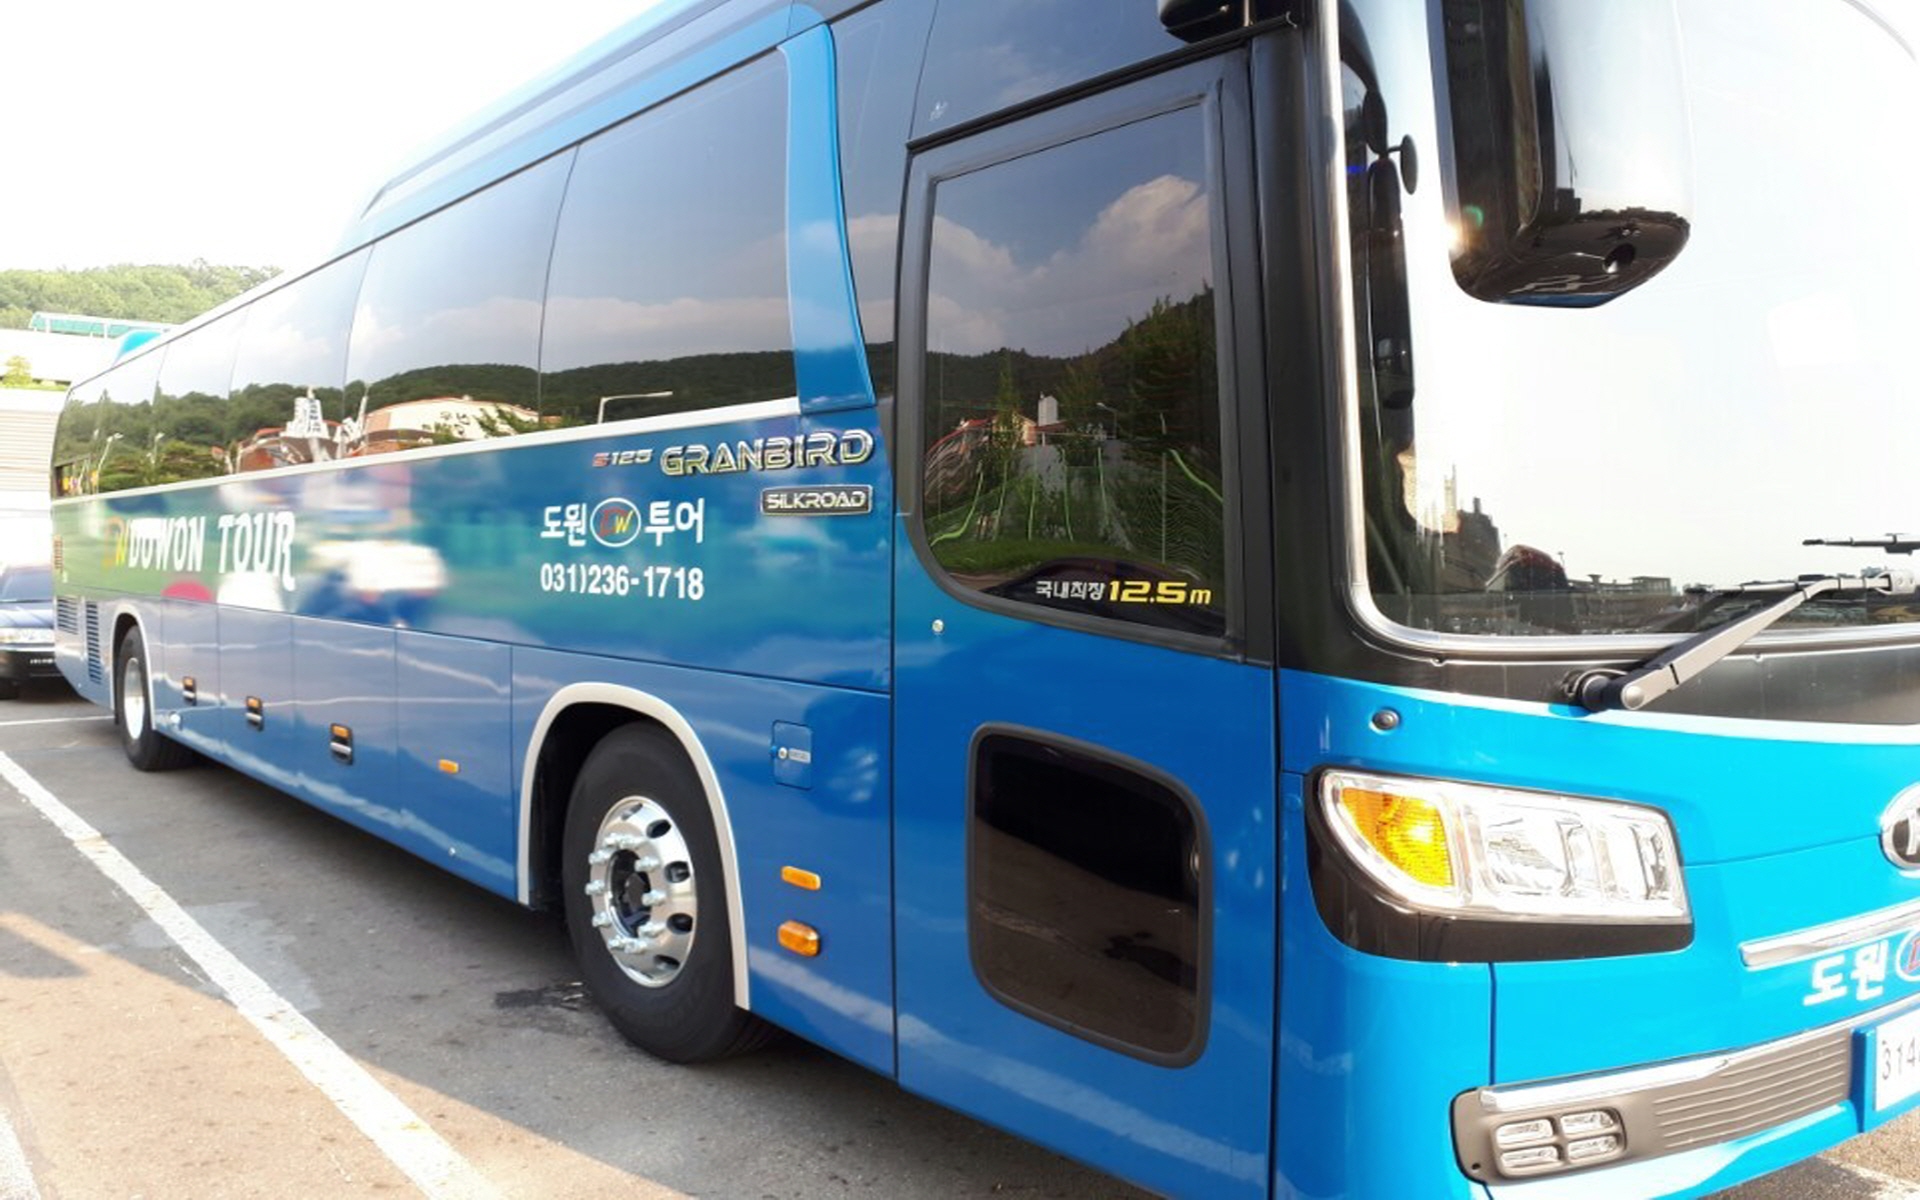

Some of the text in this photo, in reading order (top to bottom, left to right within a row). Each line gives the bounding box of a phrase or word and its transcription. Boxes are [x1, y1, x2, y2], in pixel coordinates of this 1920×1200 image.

[658, 429, 875, 476] GRANBIRD
[540, 502, 587, 547] 도원
[645, 497, 705, 547] 투어
[766, 490, 867, 510] SILKROAD
[218, 510, 296, 592] TOUR
[540, 563, 705, 600] 031)236-1718
[1035, 580, 1106, 600] 국내최장
[1803, 939, 1889, 1006] 도원
[1881, 1036, 1920, 1080] 314
